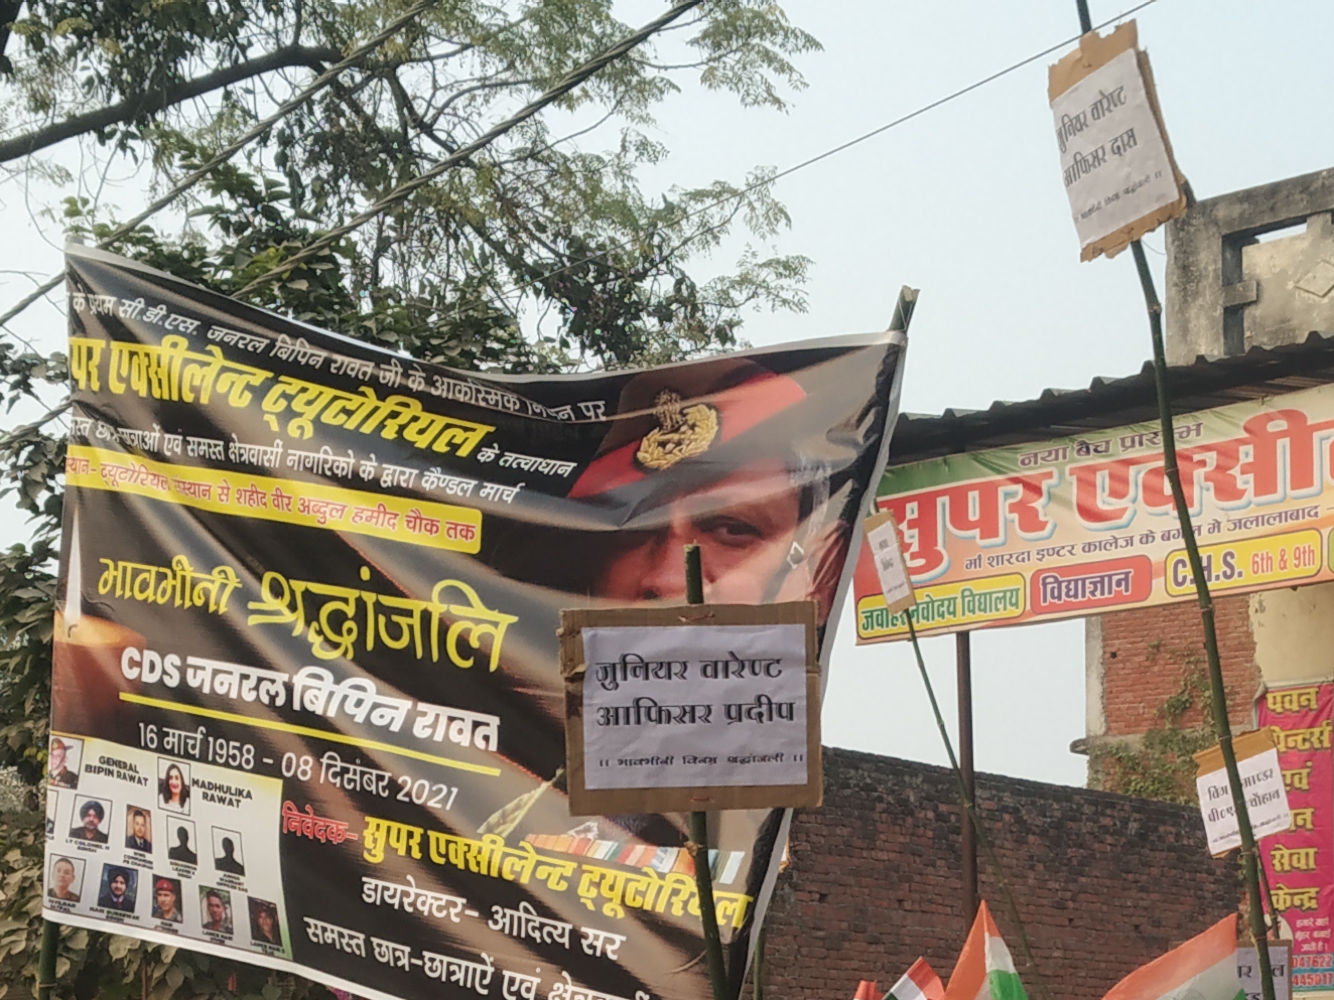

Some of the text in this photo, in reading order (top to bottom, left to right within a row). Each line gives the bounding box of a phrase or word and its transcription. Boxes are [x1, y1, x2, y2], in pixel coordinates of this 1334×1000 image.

[206, 325, 271, 355] जनरल
[269, 333, 328, 370] बिपिन
[329, 352, 375, 382] रावत
[379, 358, 403, 388] जी
[408, 366, 426, 393] के
[578, 400, 607, 422] पर
[68, 334, 578, 479] पर एक्सीलेन्ट ट्यूटोरियल के तत्वाधान
[164, 428, 183, 457] एवं
[186, 435, 225, 462] समस्त
[358, 454, 377, 482] के
[379, 462, 419, 489] द्वारा
[421, 467, 479, 498] कैण्डल
[479, 481, 526, 505] मार्च
[1018, 446, 1069, 470] नया
[1074, 431, 1116, 458] बैच
[217, 479, 230, 504] से
[235, 483, 268, 510] शहीद
[270, 487, 293, 513] वीर
[350, 502, 400, 531] हमीद
[405, 508, 441, 536] चौक
[445, 520, 477, 543] तक
[876, 464, 1059, 578] सुपर
[986, 547, 1033, 570] शारदा
[1035, 540, 1078, 564] इण्टर
[1081, 532, 1135, 556] कालेज
[1139, 527, 1158, 549] के
[1226, 503, 1320, 535] जलालाबाद
[1251, 552, 1274, 576] 6th
[1278, 548, 1289, 571] &
[1293, 543, 1317, 570] 9th
[97, 554, 519, 674] भावभीनी श्रद्धांजलि
[961, 584, 1022, 616] विद्यालय
[698, 650, 784, 682] वारेण्ट
[120, 645, 502, 753] CDS जनरल बिपिन रावत
[596, 693, 797, 727] आफिसर प्रदीप
[1266, 687, 1320, 713] पवन
[84, 763, 149, 788] BIPIN RAWAT
[98, 755, 140, 775] GENERAL
[138, 722, 460, 812] 16 मार्च 1958 08 दिसंबर 2021
[191, 777, 253, 801] MADHULIKA
[201, 790, 243, 809] RAWAT
[362, 815, 425, 865] सुपर
[428, 830, 577, 894] एक्सीलेन्ट
[1270, 844, 1318, 872] सेवा
[303, 916, 367, 959] समस्त
[488, 901, 574, 950] आदित्य
[580, 926, 628, 961] सर
